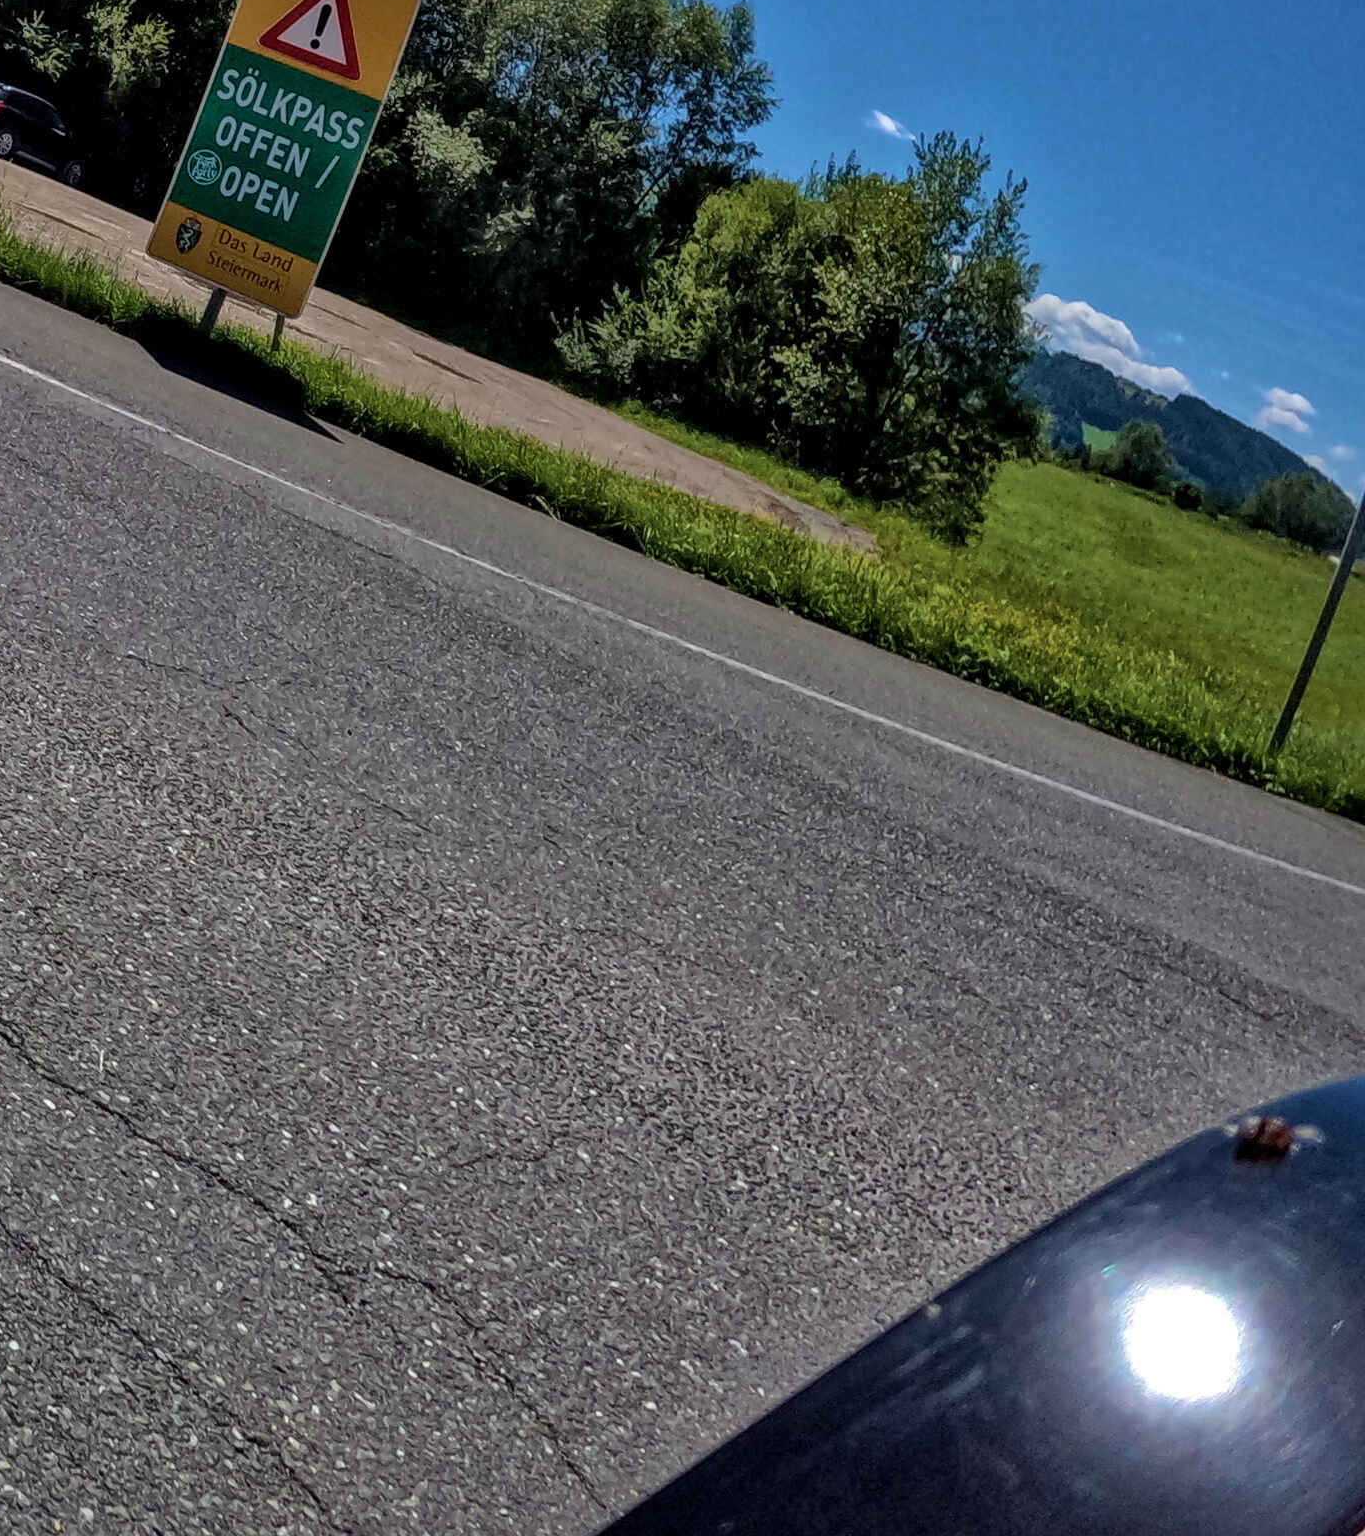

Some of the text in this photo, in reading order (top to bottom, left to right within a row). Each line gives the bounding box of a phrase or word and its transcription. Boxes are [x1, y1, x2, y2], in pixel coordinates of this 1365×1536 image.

[216, 67, 365, 150] SÖLKPASS
[215, 115, 341, 190] OFFEN /
[219, 165, 300, 223] OPEN
[208, 250, 284, 293] Steiermark
[218, 228, 294, 273] Das Land
